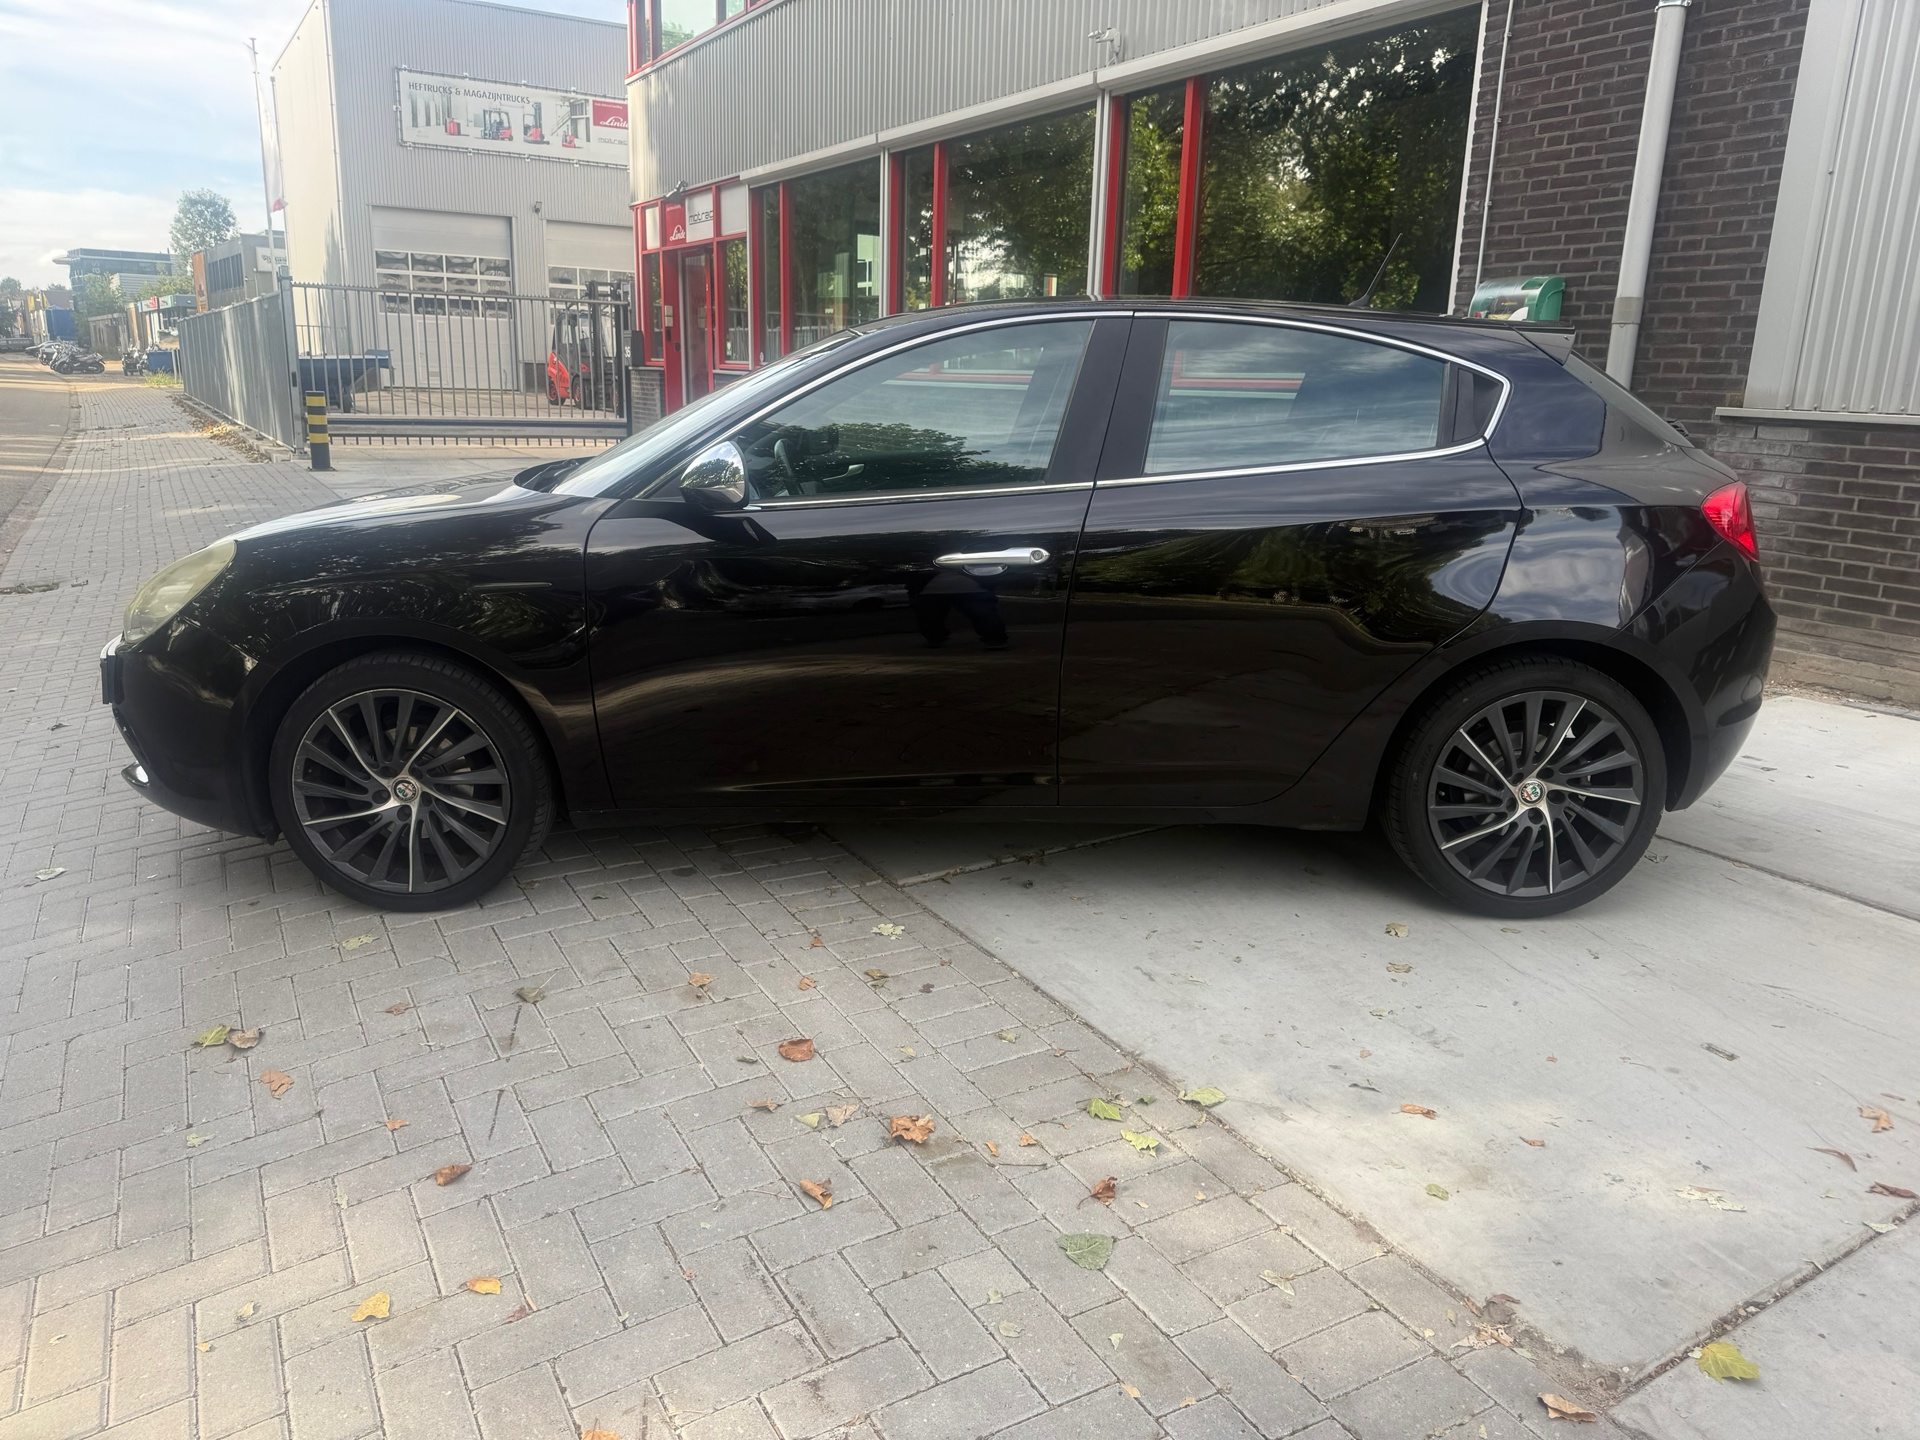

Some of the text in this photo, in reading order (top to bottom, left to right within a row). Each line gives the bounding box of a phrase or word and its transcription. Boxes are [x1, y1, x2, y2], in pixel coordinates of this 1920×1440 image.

[408, 81, 531, 105] HEFTRUCKS & MAGAZIJNTRUCKS
[689, 210, 713, 223] motrac
[669, 224, 686, 242] Linde
[684, 345, 692, 358] 35
